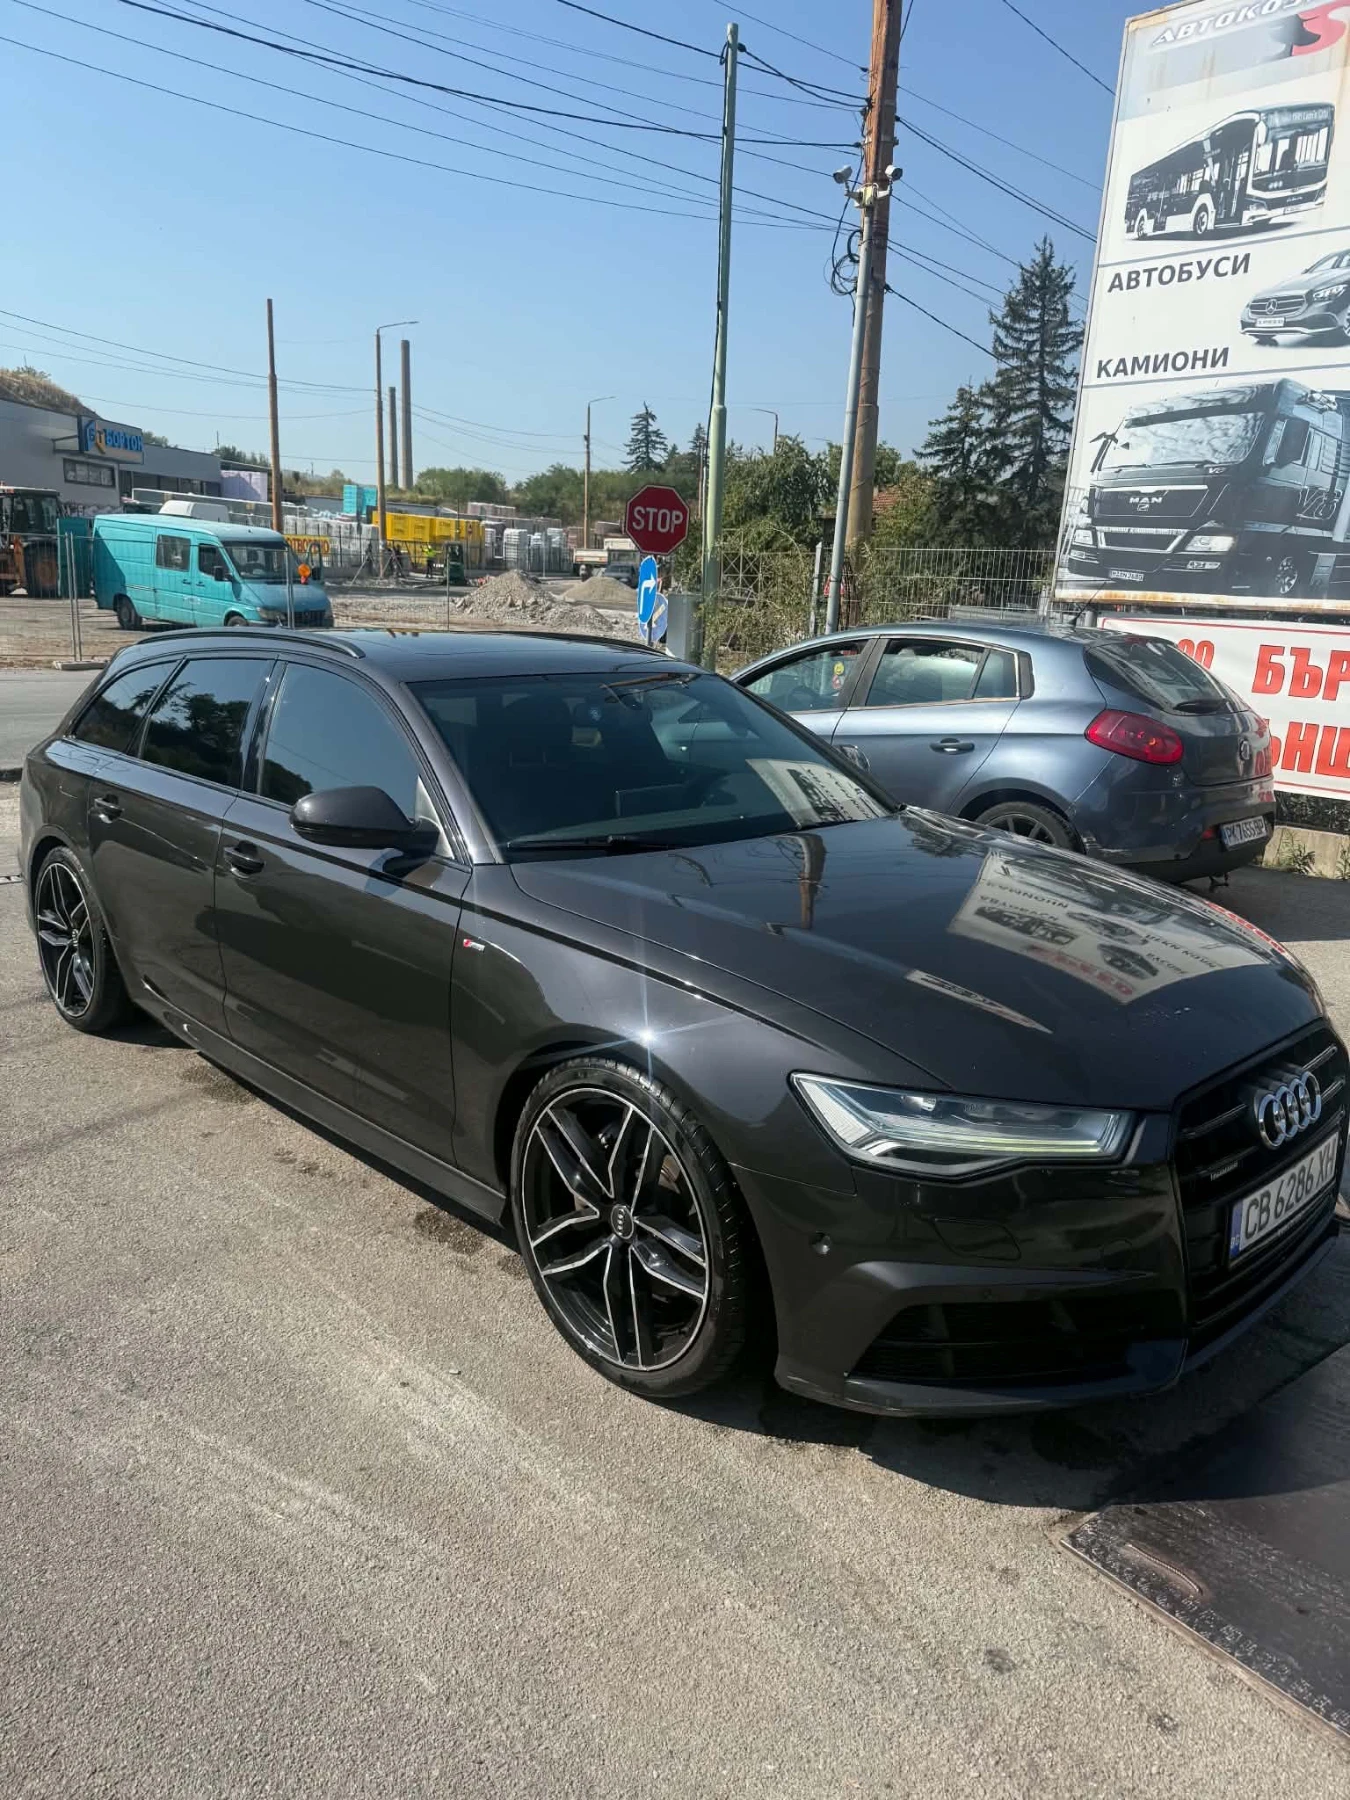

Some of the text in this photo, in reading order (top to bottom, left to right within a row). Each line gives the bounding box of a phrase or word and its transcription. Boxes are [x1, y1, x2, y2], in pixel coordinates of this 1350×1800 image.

[1107, 252, 1251, 293] АВТОБУСИ
[1096, 347, 1229, 379] КАМИОНИ
[632, 506, 684, 533] STOP
[1245, 1189, 1271, 1239] CB
[1274, 1156, 1314, 1219] 6286
